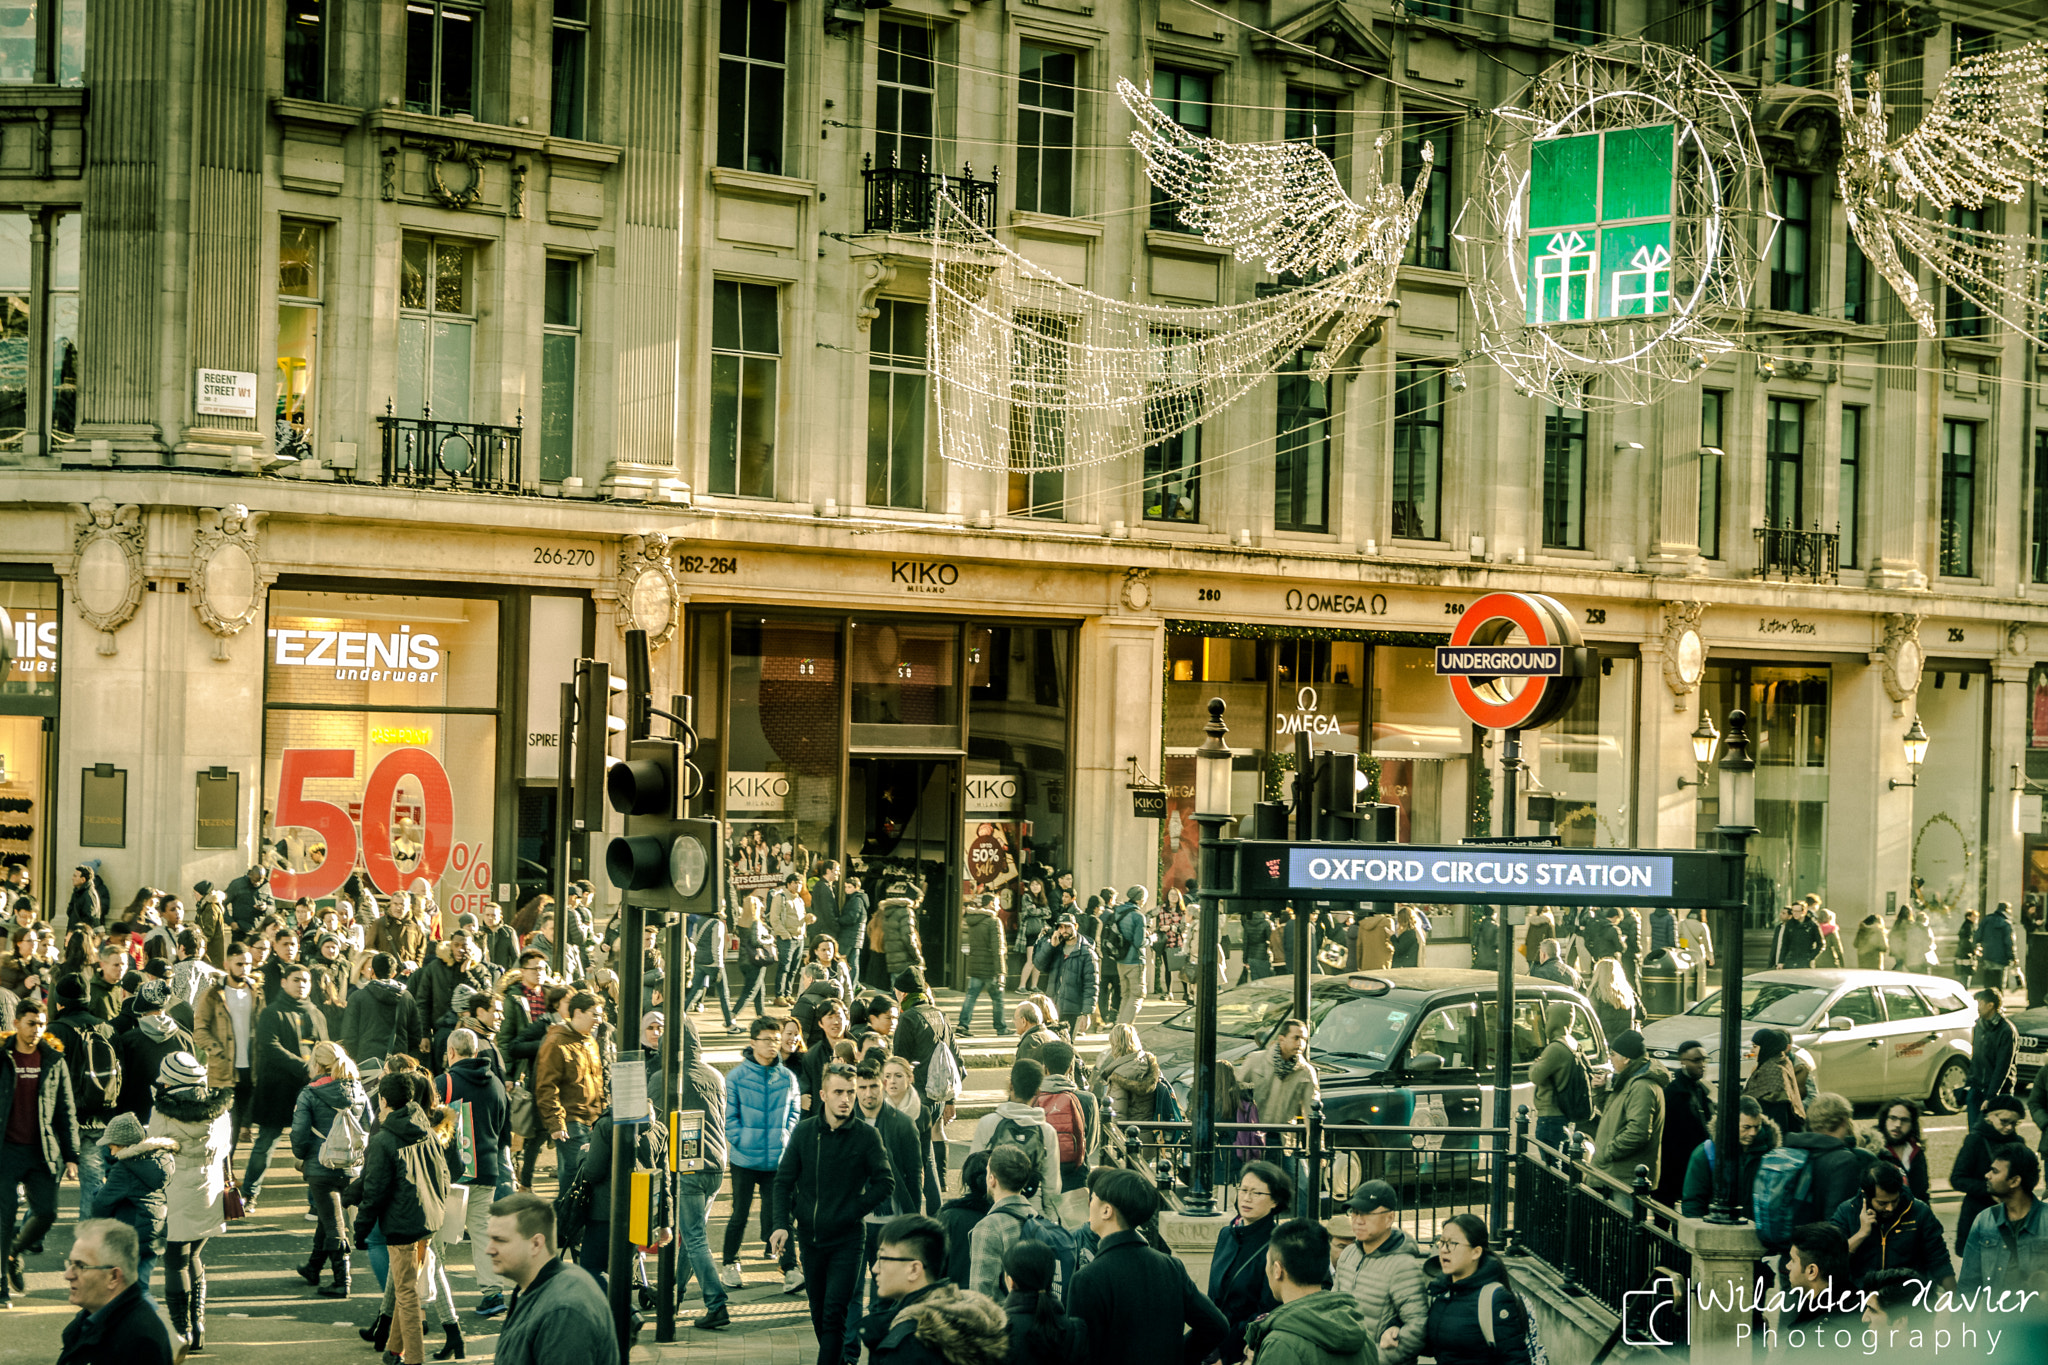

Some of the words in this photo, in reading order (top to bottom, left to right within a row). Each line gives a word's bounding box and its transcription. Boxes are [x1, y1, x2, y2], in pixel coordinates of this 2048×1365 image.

[204, 373, 237, 384] REGENT
[204, 385, 235, 396] STREET
[238, 387, 251, 397] W1
[534, 547, 594, 566] 266-270
[680, 555, 738, 574] 262-264
[892, 561, 958, 585] KIKO
[907, 585, 945, 593] MILANO
[1198, 589, 1221, 601] 260
[1307, 594, 1366, 613] OMEGA
[1445, 603, 1465, 615] 260
[1586, 609, 1606, 624] 258
[1947, 628, 1964, 642] 256
[1441, 653, 1556, 669] UNDERGROUND
[336, 667, 438, 682] underwear
[728, 777, 789, 797] KIKO
[966, 780, 1017, 798] KIKO
[1167, 785, 1196, 797] MEGA
[1135, 797, 1164, 809] KIKO
[84, 816, 122, 825] TEZENIS
[200, 819, 235, 827] TEZENIS
[972, 848, 999, 862] 50%
[1309, 858, 1424, 881] OXFORD
[1431, 861, 1529, 885] CIRCUS
[1536, 864, 1652, 887] STATION
[451, 893, 490, 916] OFF
